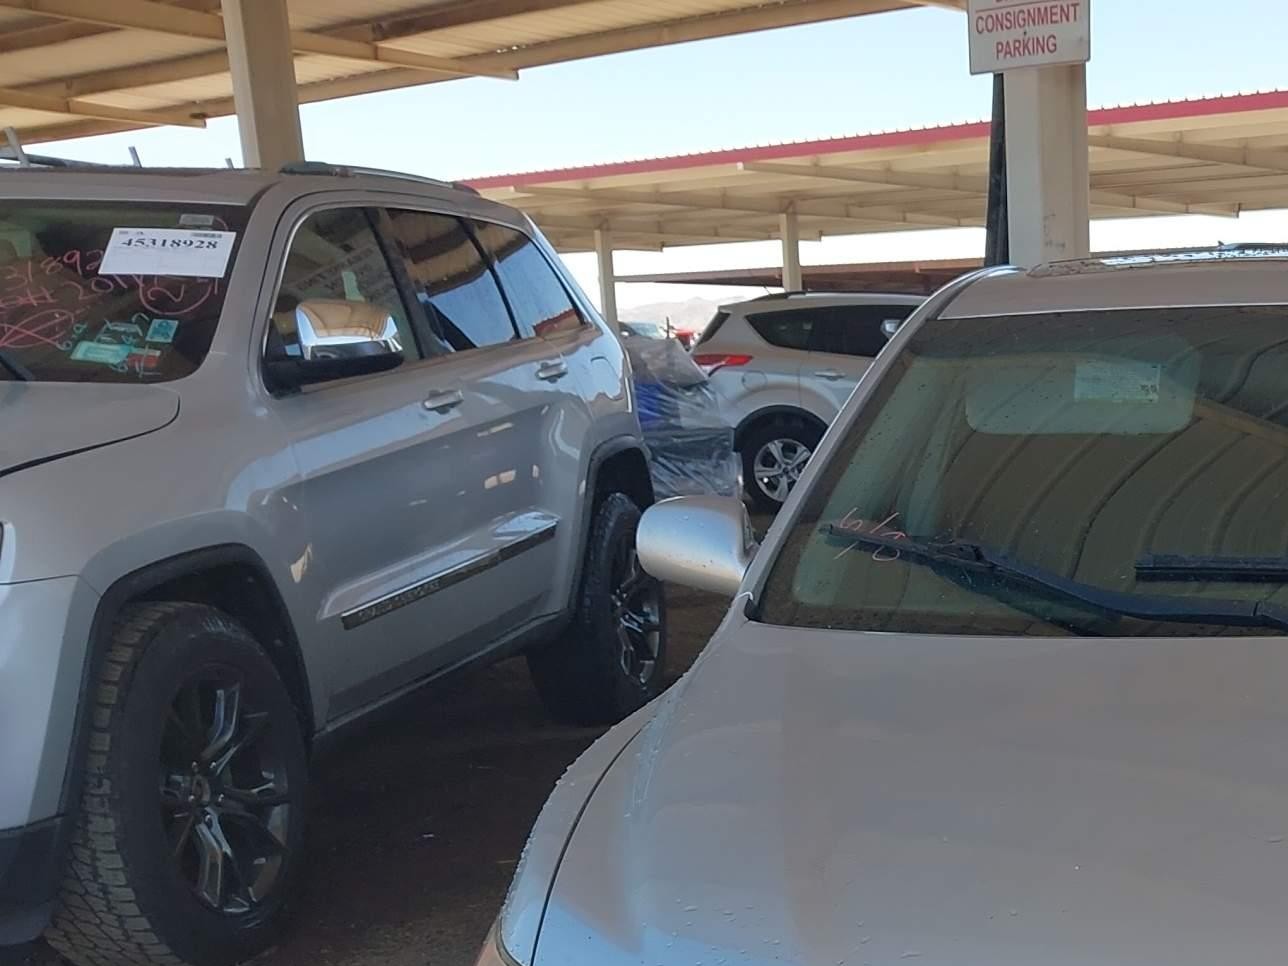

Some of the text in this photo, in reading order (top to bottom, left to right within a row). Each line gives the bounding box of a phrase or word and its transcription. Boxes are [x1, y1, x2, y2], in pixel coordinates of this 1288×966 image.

[975, 3, 1080, 35] CONSIGNMENT
[995, 34, 1058, 60] PARKING
[121, 237, 219, 250] 45318928
